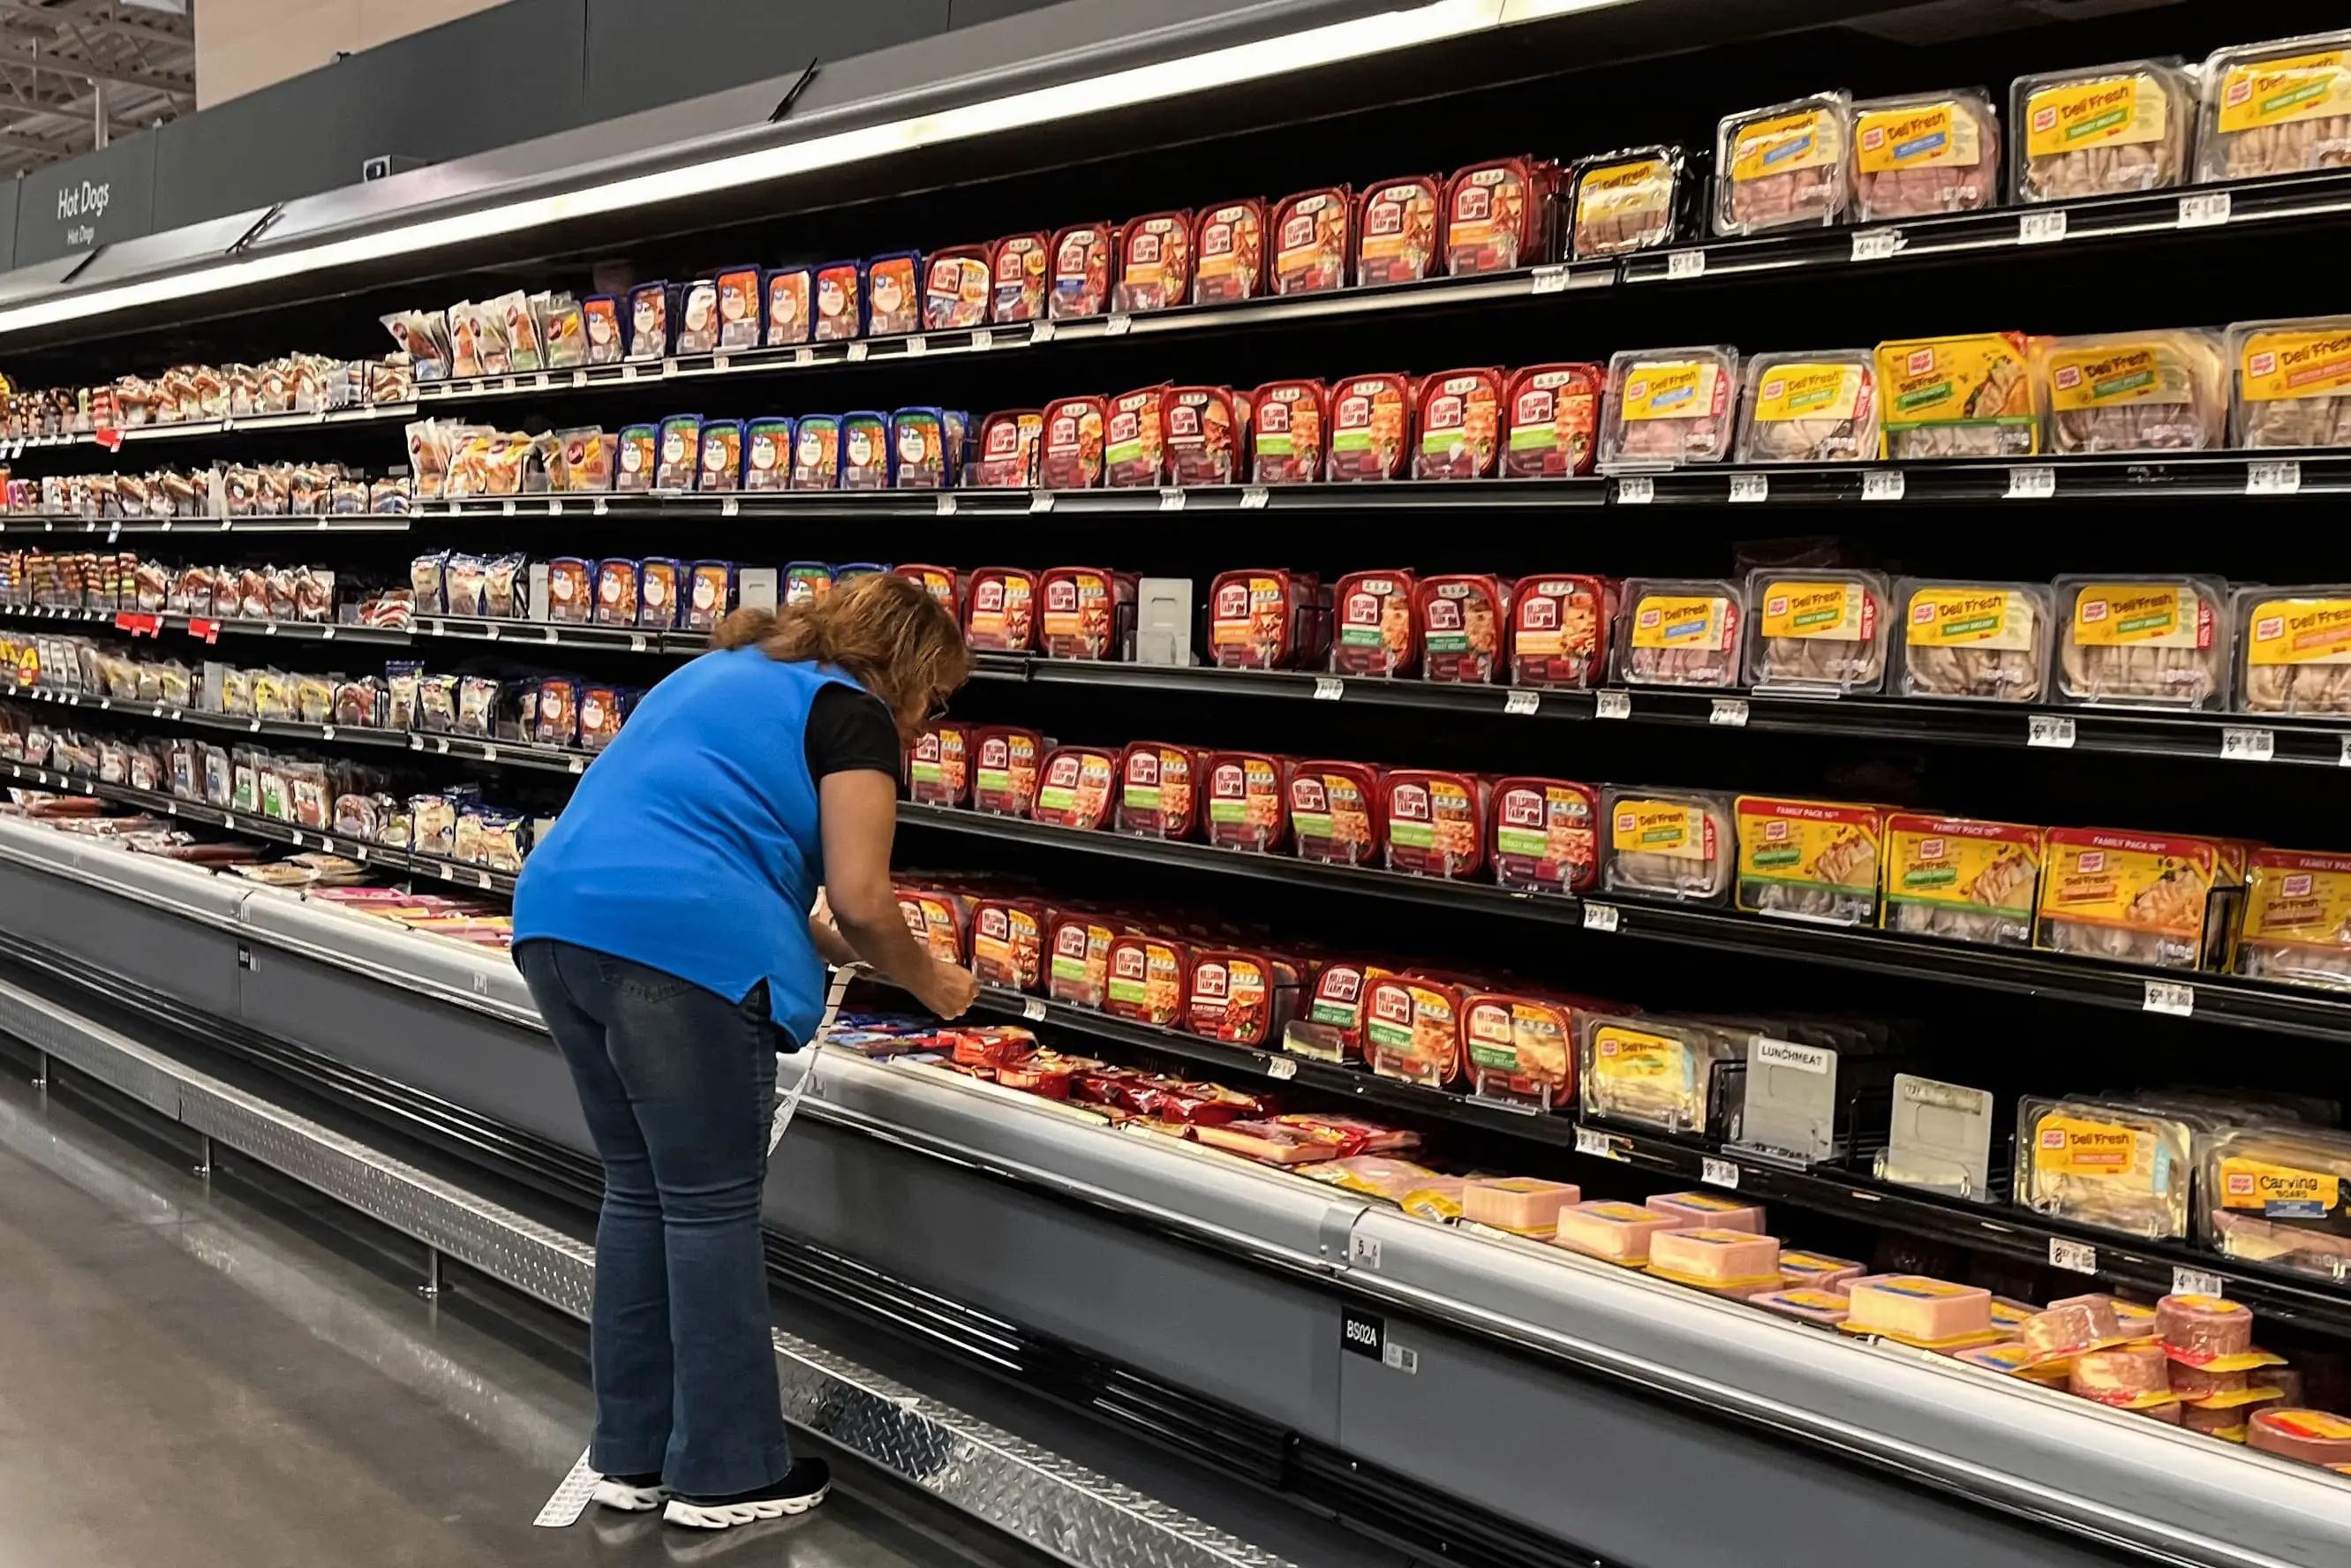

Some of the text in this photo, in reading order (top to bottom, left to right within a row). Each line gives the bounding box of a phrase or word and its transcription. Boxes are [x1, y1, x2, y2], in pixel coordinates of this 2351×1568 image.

[2061, 86, 2128, 118] Deli Fresh
[1888, 123, 1909, 140] Deli
[1910, 112, 1945, 132] Fresh
[57, 180, 109, 220] Hot Dogs
[2084, 351, 2149, 378] Deli Fresh
[2281, 347, 2310, 365] Deli
[1670, 371, 1696, 385] Fresh
[1807, 372, 1839, 385] Fresh
[1792, 591, 1841, 607] Deli Fresh
[1940, 601, 1963, 616] Deli
[1966, 597, 2001, 612] Fresh
[2112, 594, 2173, 614] Deli Fresh
[1664, 608, 1683, 621] Deli
[1684, 604, 1707, 617] Fresh
[2291, 614, 2316, 629] Deli
[1660, 812, 1684, 823] Fresh
[2331, 861, 2351, 870] PAC
[1761, 1045, 1823, 1067] LUNCHMEAT
[2070, 1134, 2129, 1145] Deli Fresh
[2259, 1176, 2317, 1191] Carving
[1346, 1320, 1377, 1346] BS02A
